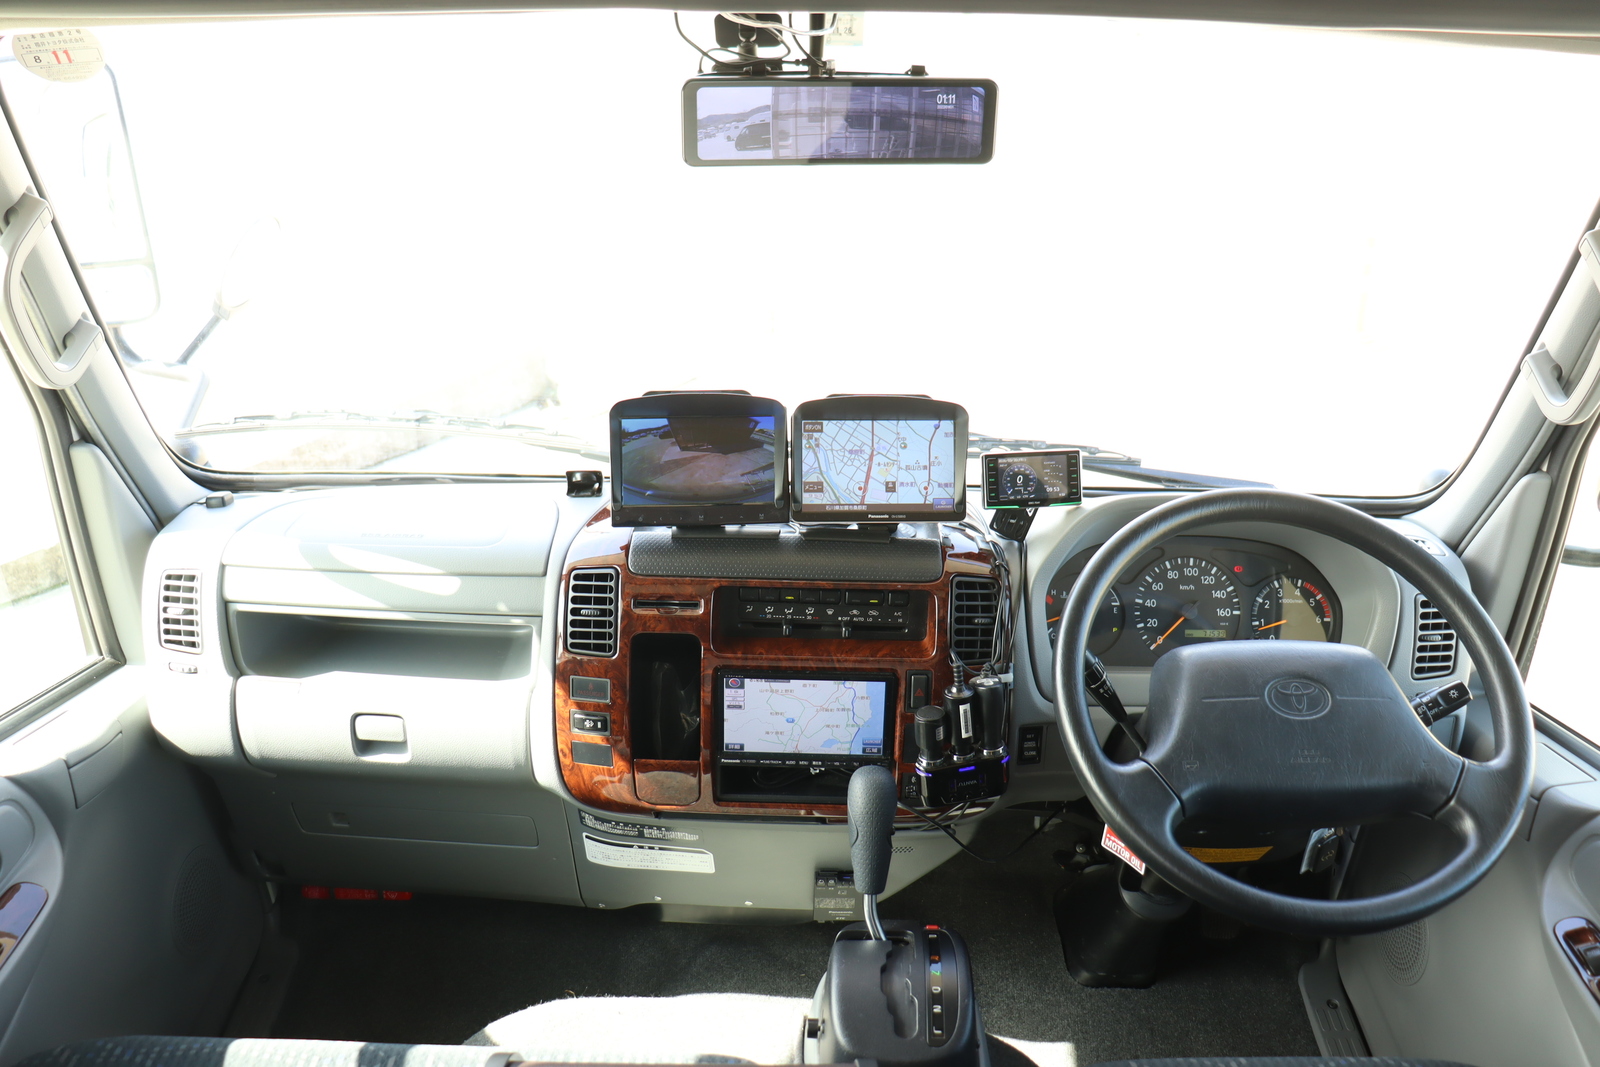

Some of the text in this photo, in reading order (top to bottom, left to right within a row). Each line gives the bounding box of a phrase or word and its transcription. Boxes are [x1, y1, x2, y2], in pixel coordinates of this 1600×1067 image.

[33, 50, 72, 64] 8 11
[1016, 475, 1023, 483] 0
[1167, 570, 1179, 579] 80
[1184, 568, 1198, 576] 100
[1200, 576, 1214, 584] 120
[1152, 582, 1163, 591] 60
[1212, 590, 1226, 598] 140
[1145, 599, 1156, 607] 40
[1216, 608, 1231, 616] 160
[1147, 619, 1158, 627] 20
[1105, 838, 1130, 860] MOTOR
[1131, 856, 1141, 869] OIL
